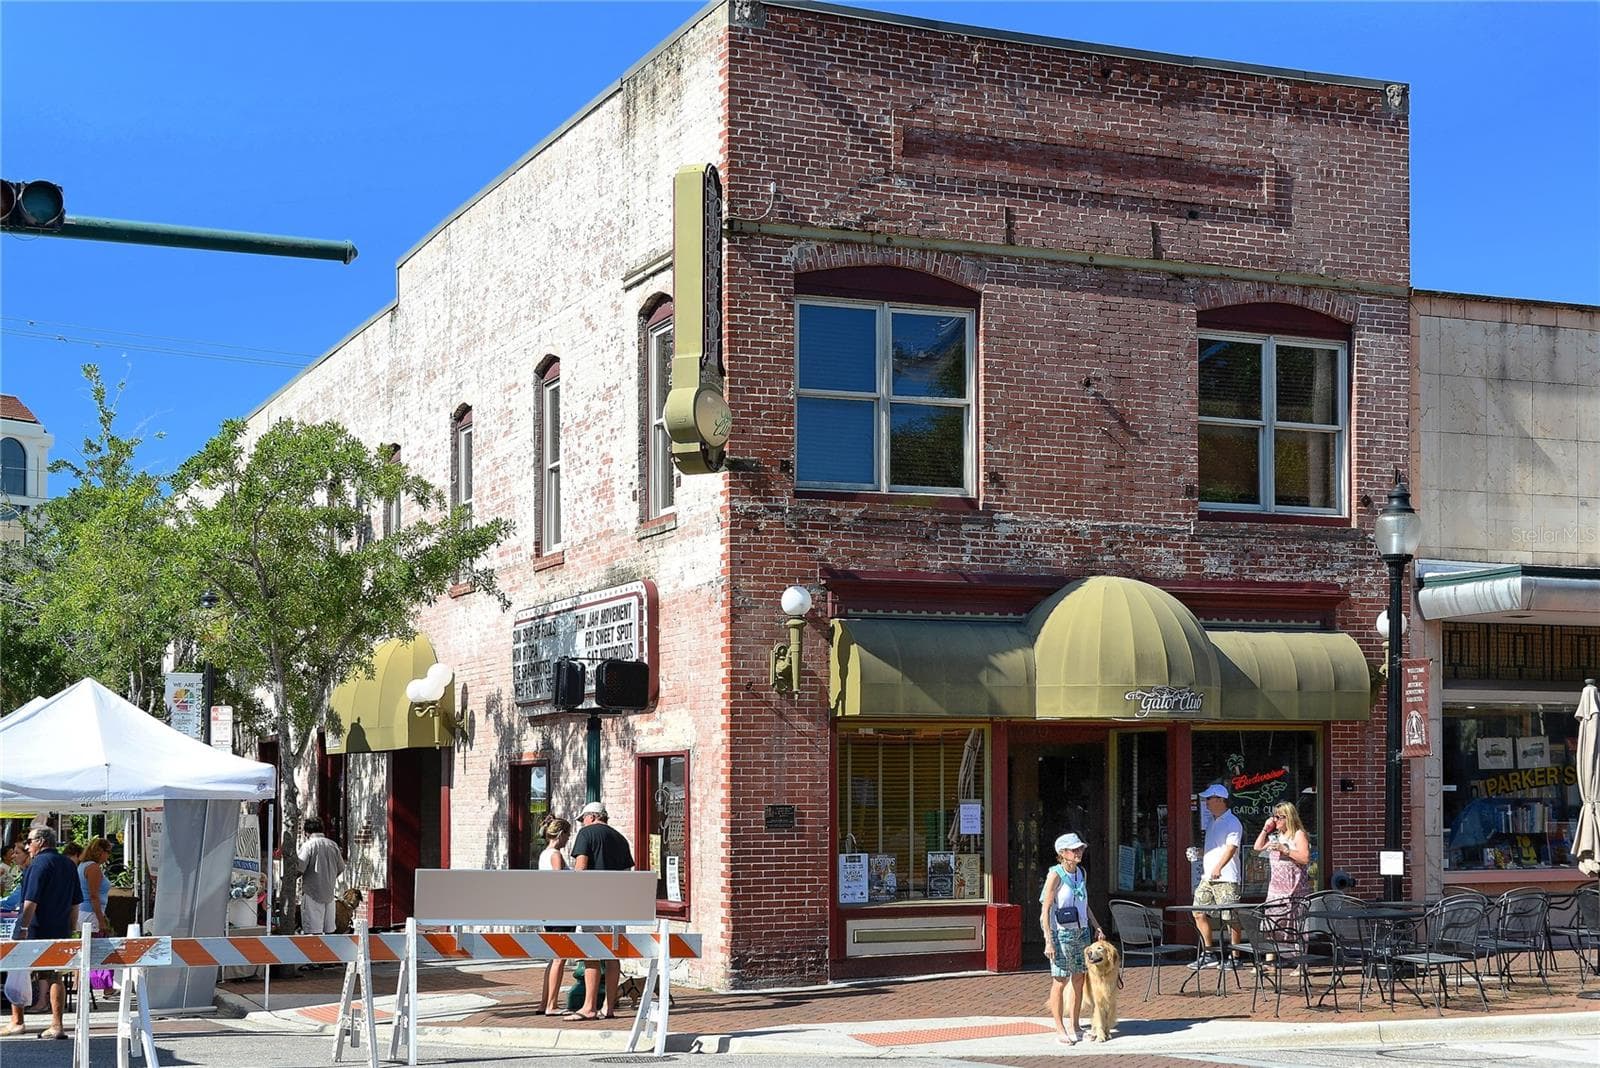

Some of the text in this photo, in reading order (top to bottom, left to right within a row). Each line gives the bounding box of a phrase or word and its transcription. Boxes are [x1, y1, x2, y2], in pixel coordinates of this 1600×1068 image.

[587, 610, 599, 627] JAH
[601, 602, 632, 625] MOVEMENT
[585, 622, 632, 647] FRI SWEET SPOT
[587, 649, 598, 667] SAT
[1135, 692, 1178, 718] Gator
[1179, 692, 1204, 711] Club
[1231, 769, 1286, 790] Budweiser
[1233, 805, 1260, 815] GATOR
